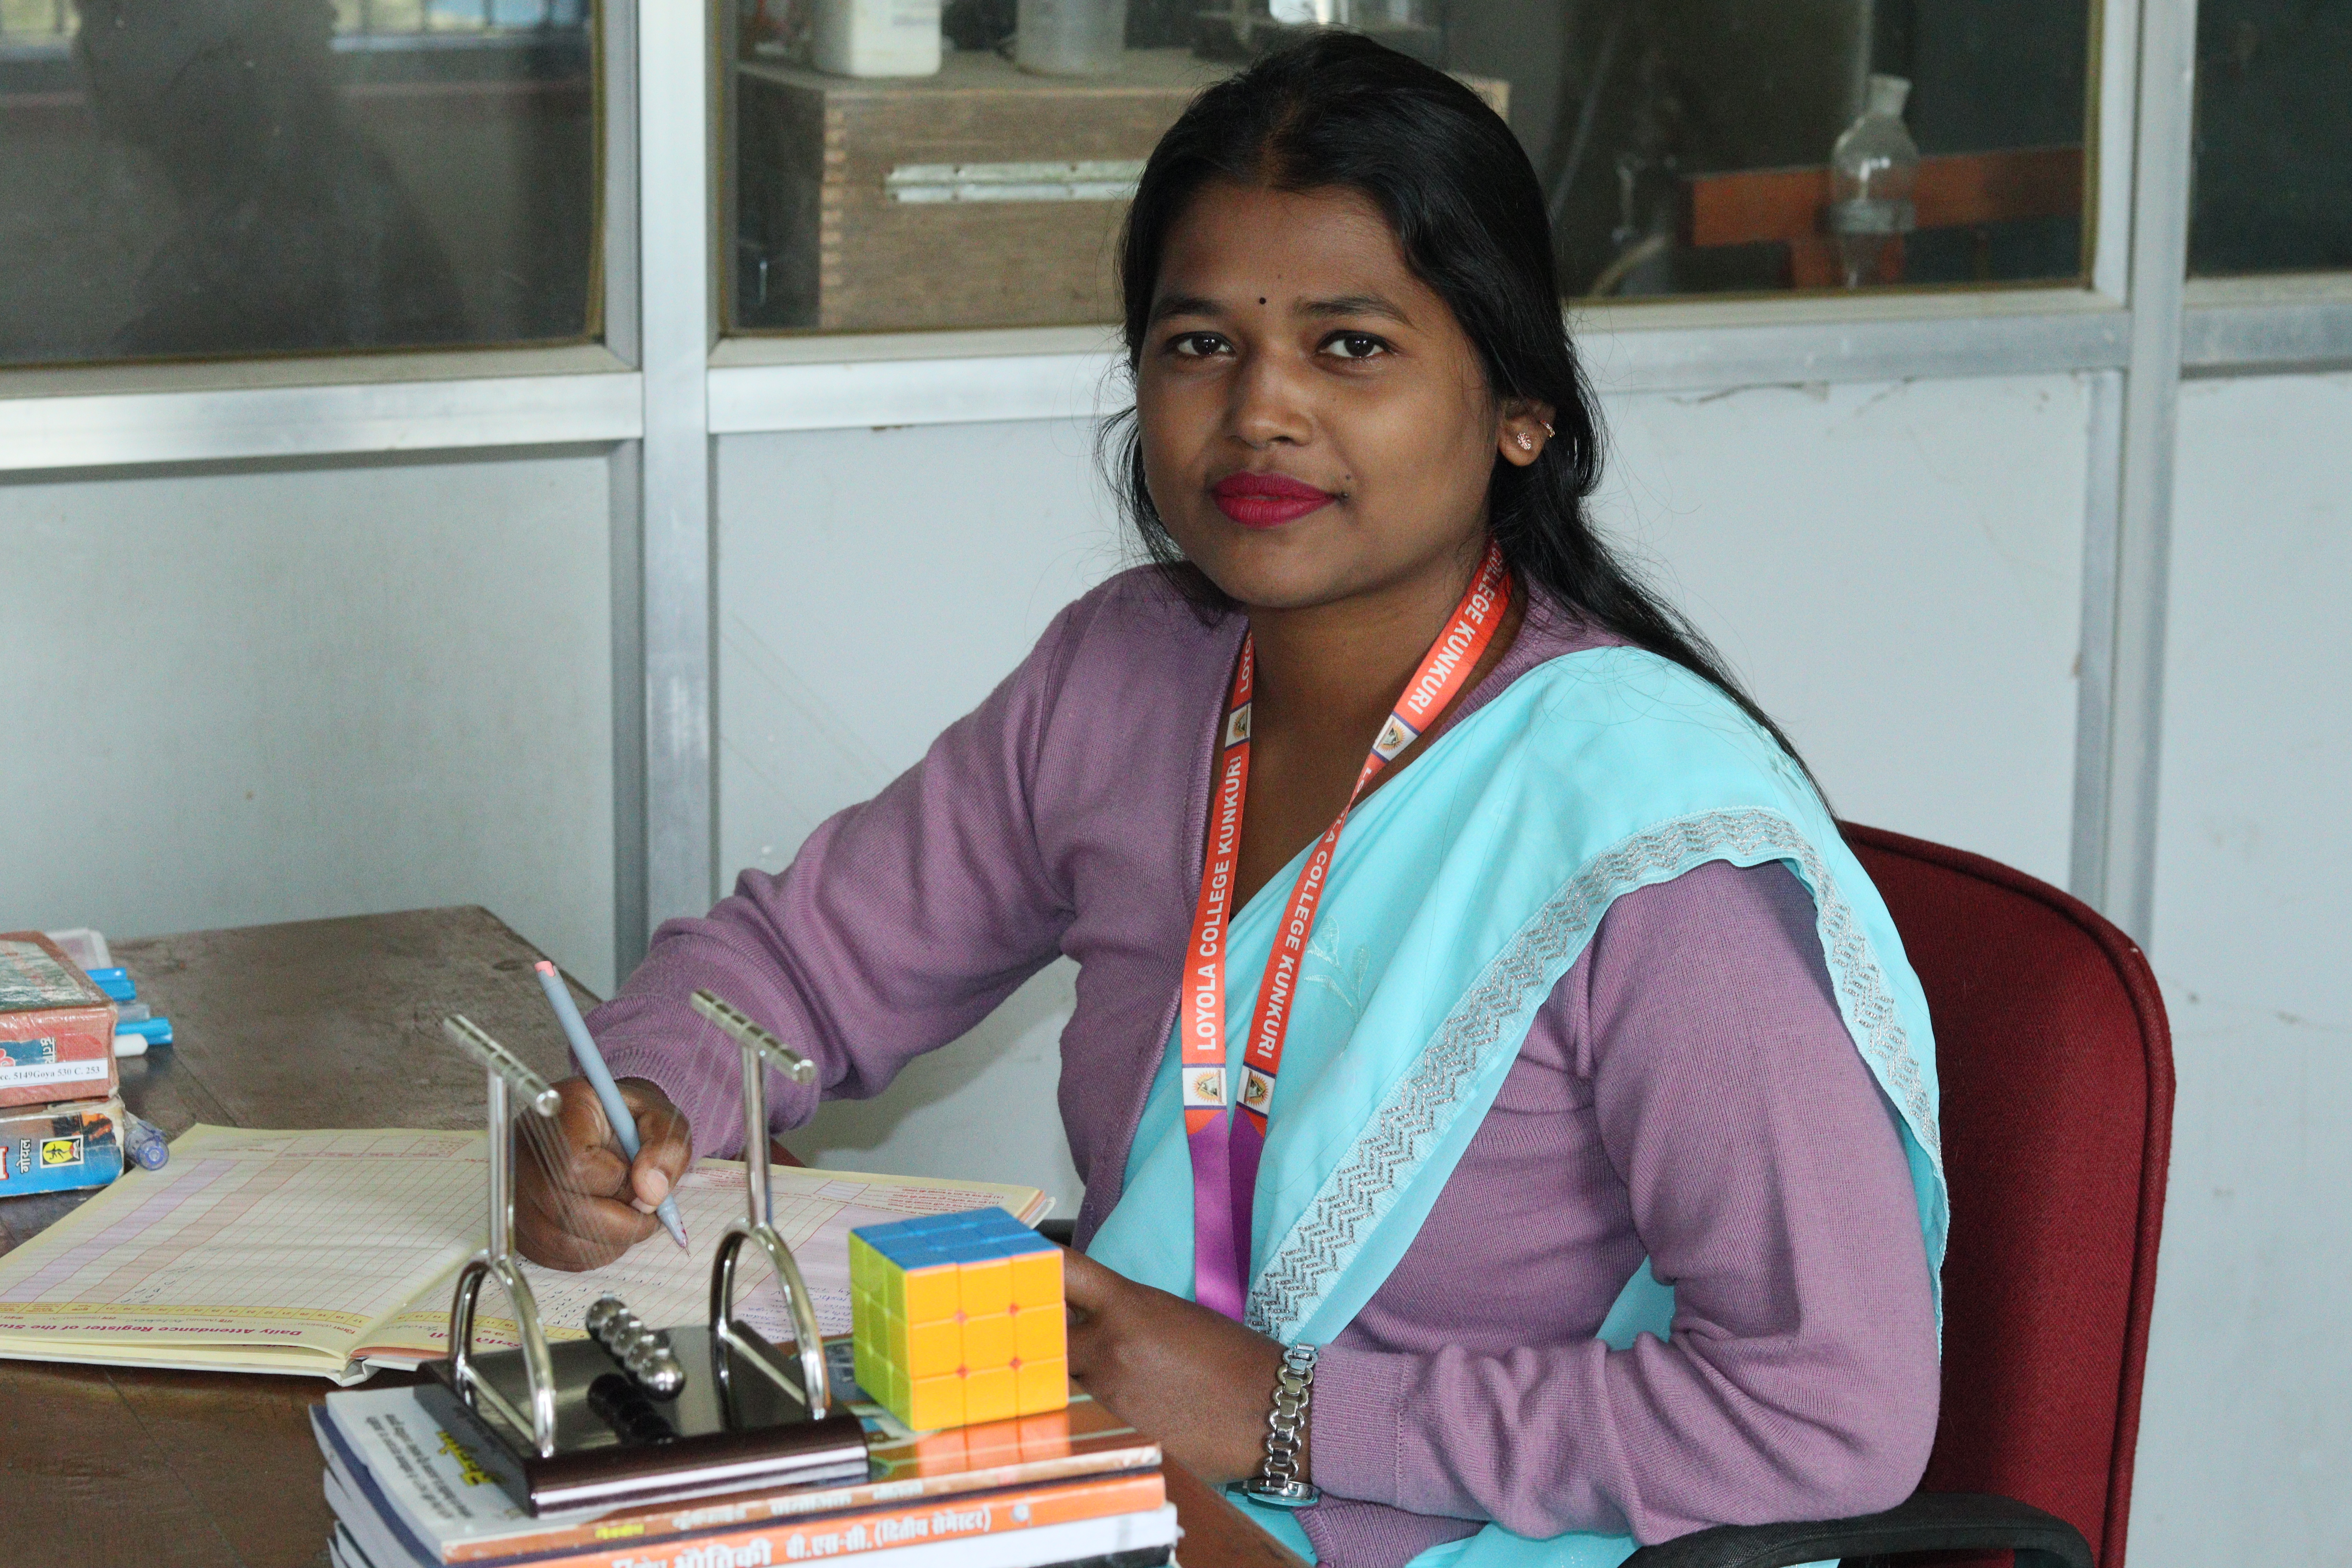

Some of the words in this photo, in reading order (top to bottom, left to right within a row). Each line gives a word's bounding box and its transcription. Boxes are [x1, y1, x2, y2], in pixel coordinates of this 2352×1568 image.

[1408, 621, 1475, 714] KUNKURI
[1218, 755, 1241, 854] KUNKURI
[1200, 860, 1229, 957] COLLEGE
[1285, 851, 1327, 950] COLLEGE
[1196, 964, 1216, 1051] LOYOLA
[1257, 955, 1294, 1058] KUNKURI
[57, 1068, 72, 1076] 530
[16, 1138, 31, 1174] गोयल
[259, 1328, 303, 1336] Daily
